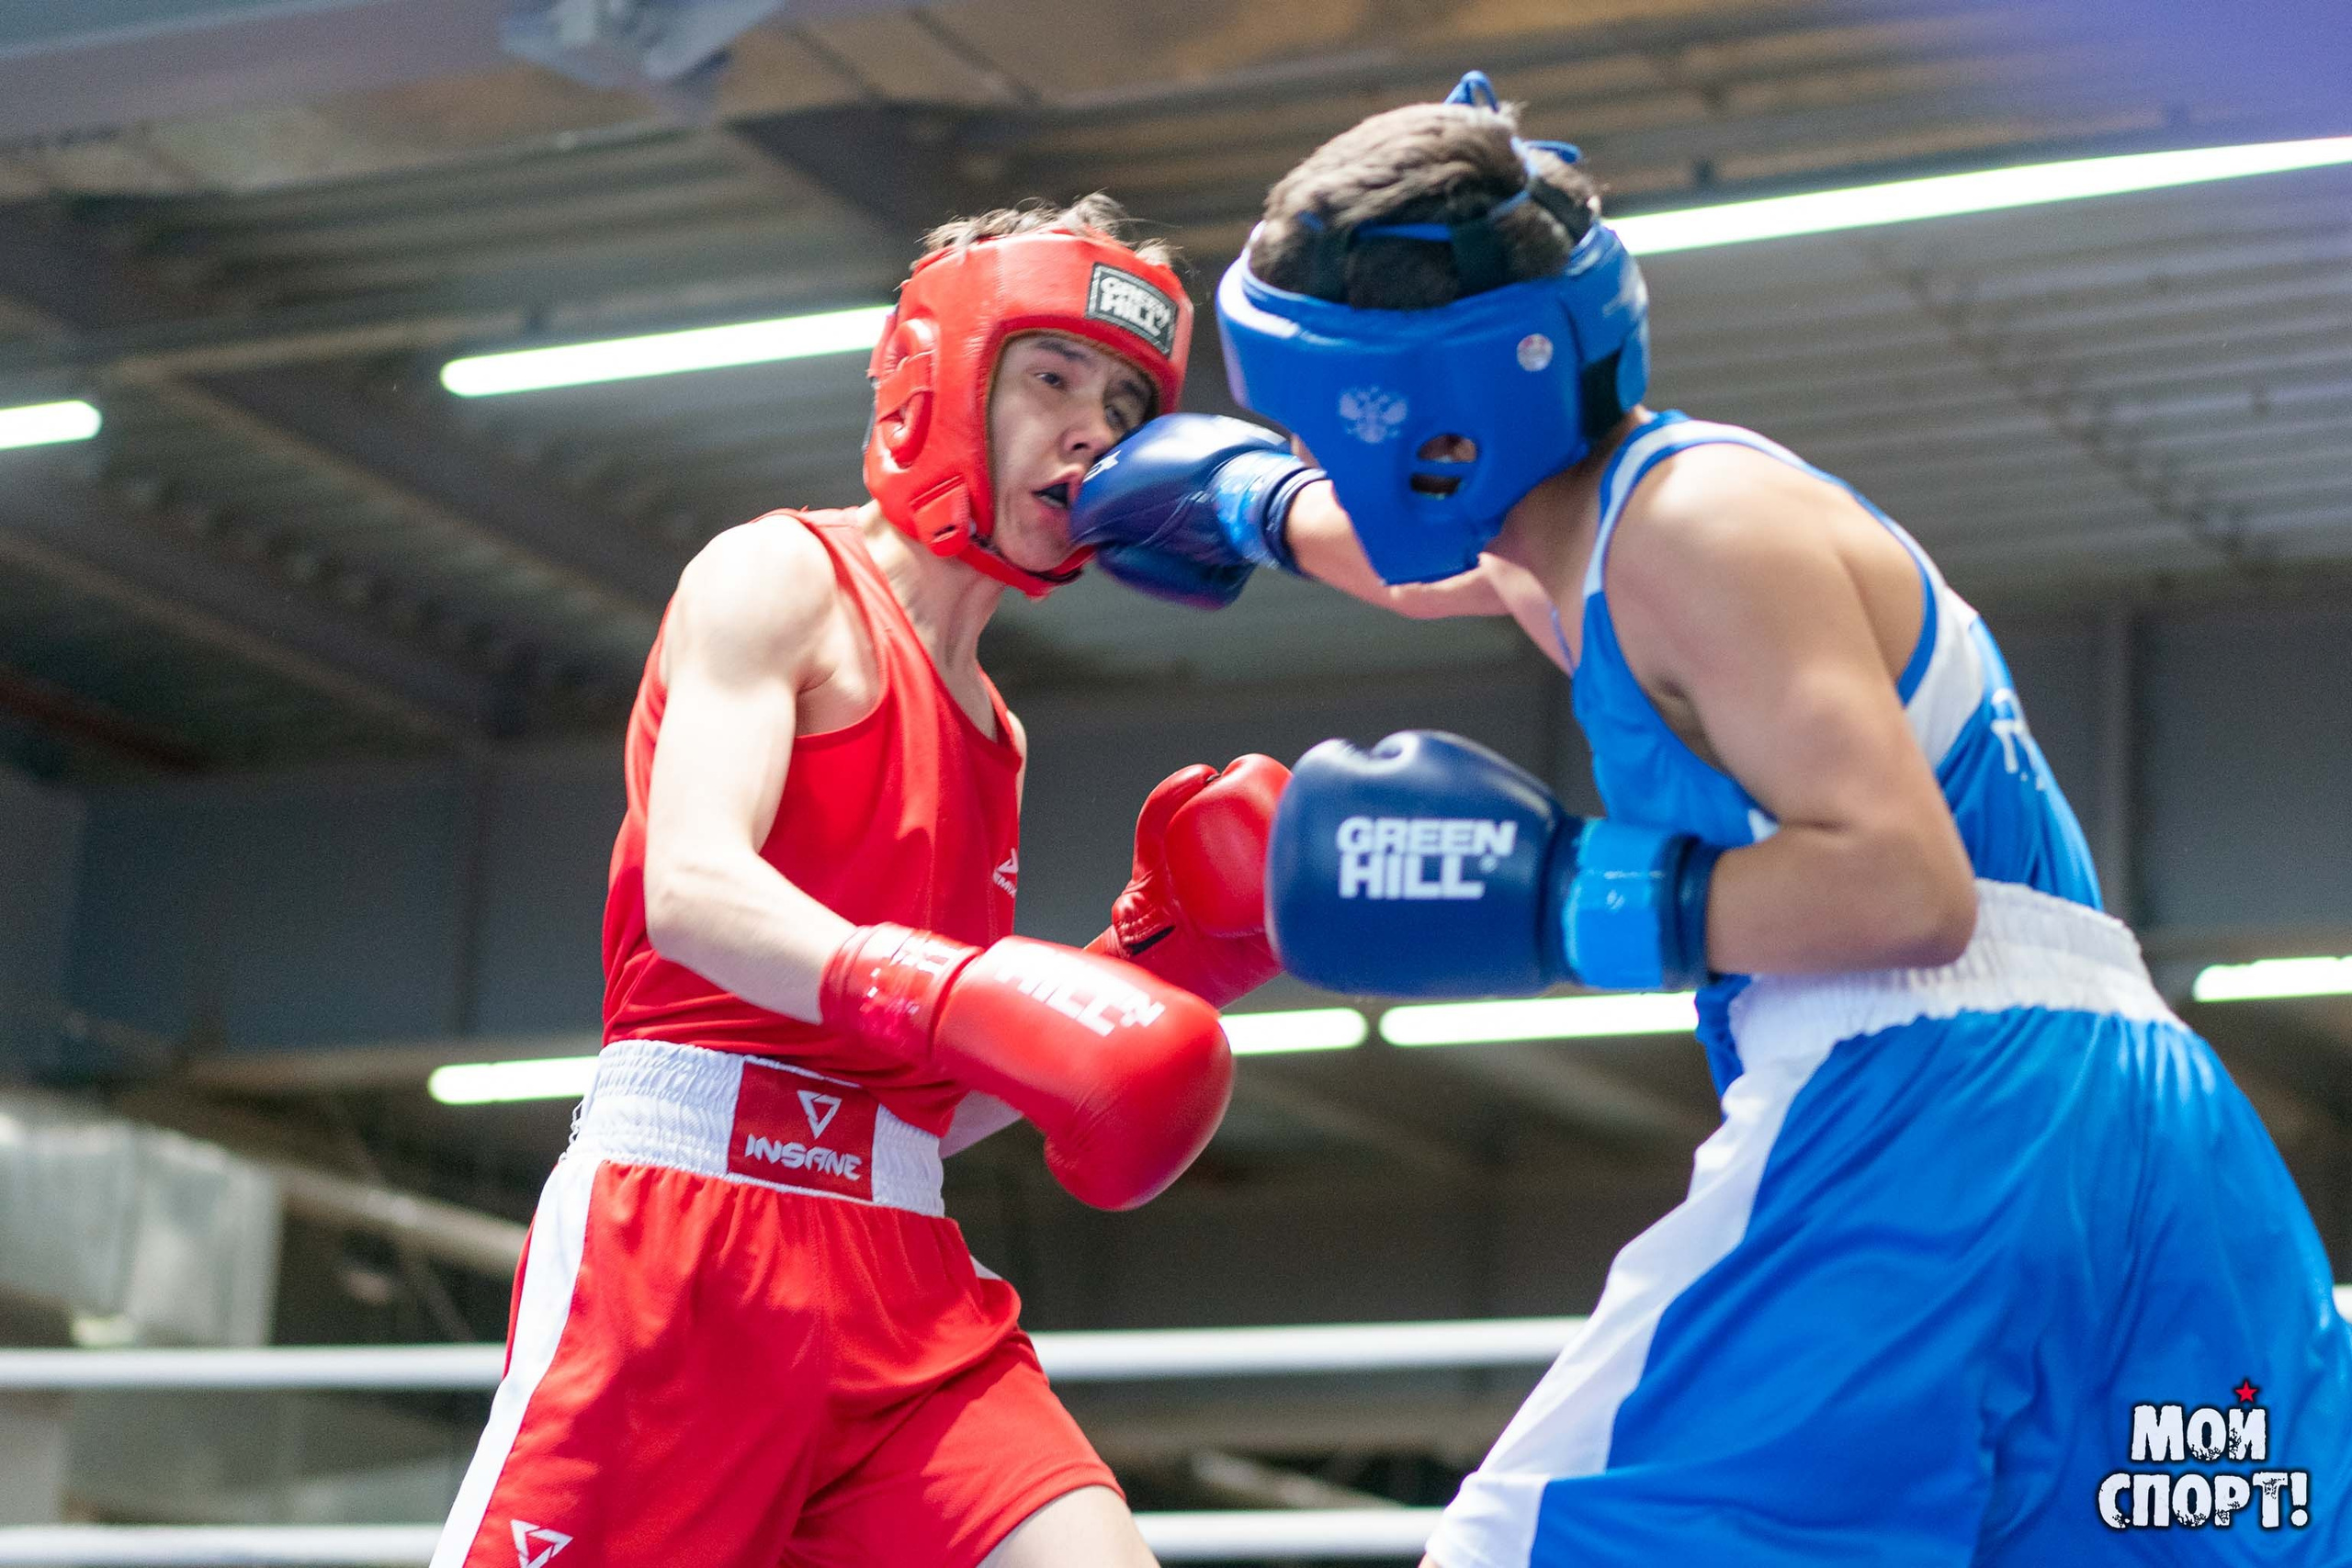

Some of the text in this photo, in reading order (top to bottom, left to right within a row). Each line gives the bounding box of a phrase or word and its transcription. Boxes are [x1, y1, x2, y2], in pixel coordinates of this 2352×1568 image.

[1337, 817, 1517, 856] GREEN
[1339, 853, 1486, 899] HILL
[745, 1133, 863, 1181] INSANE
